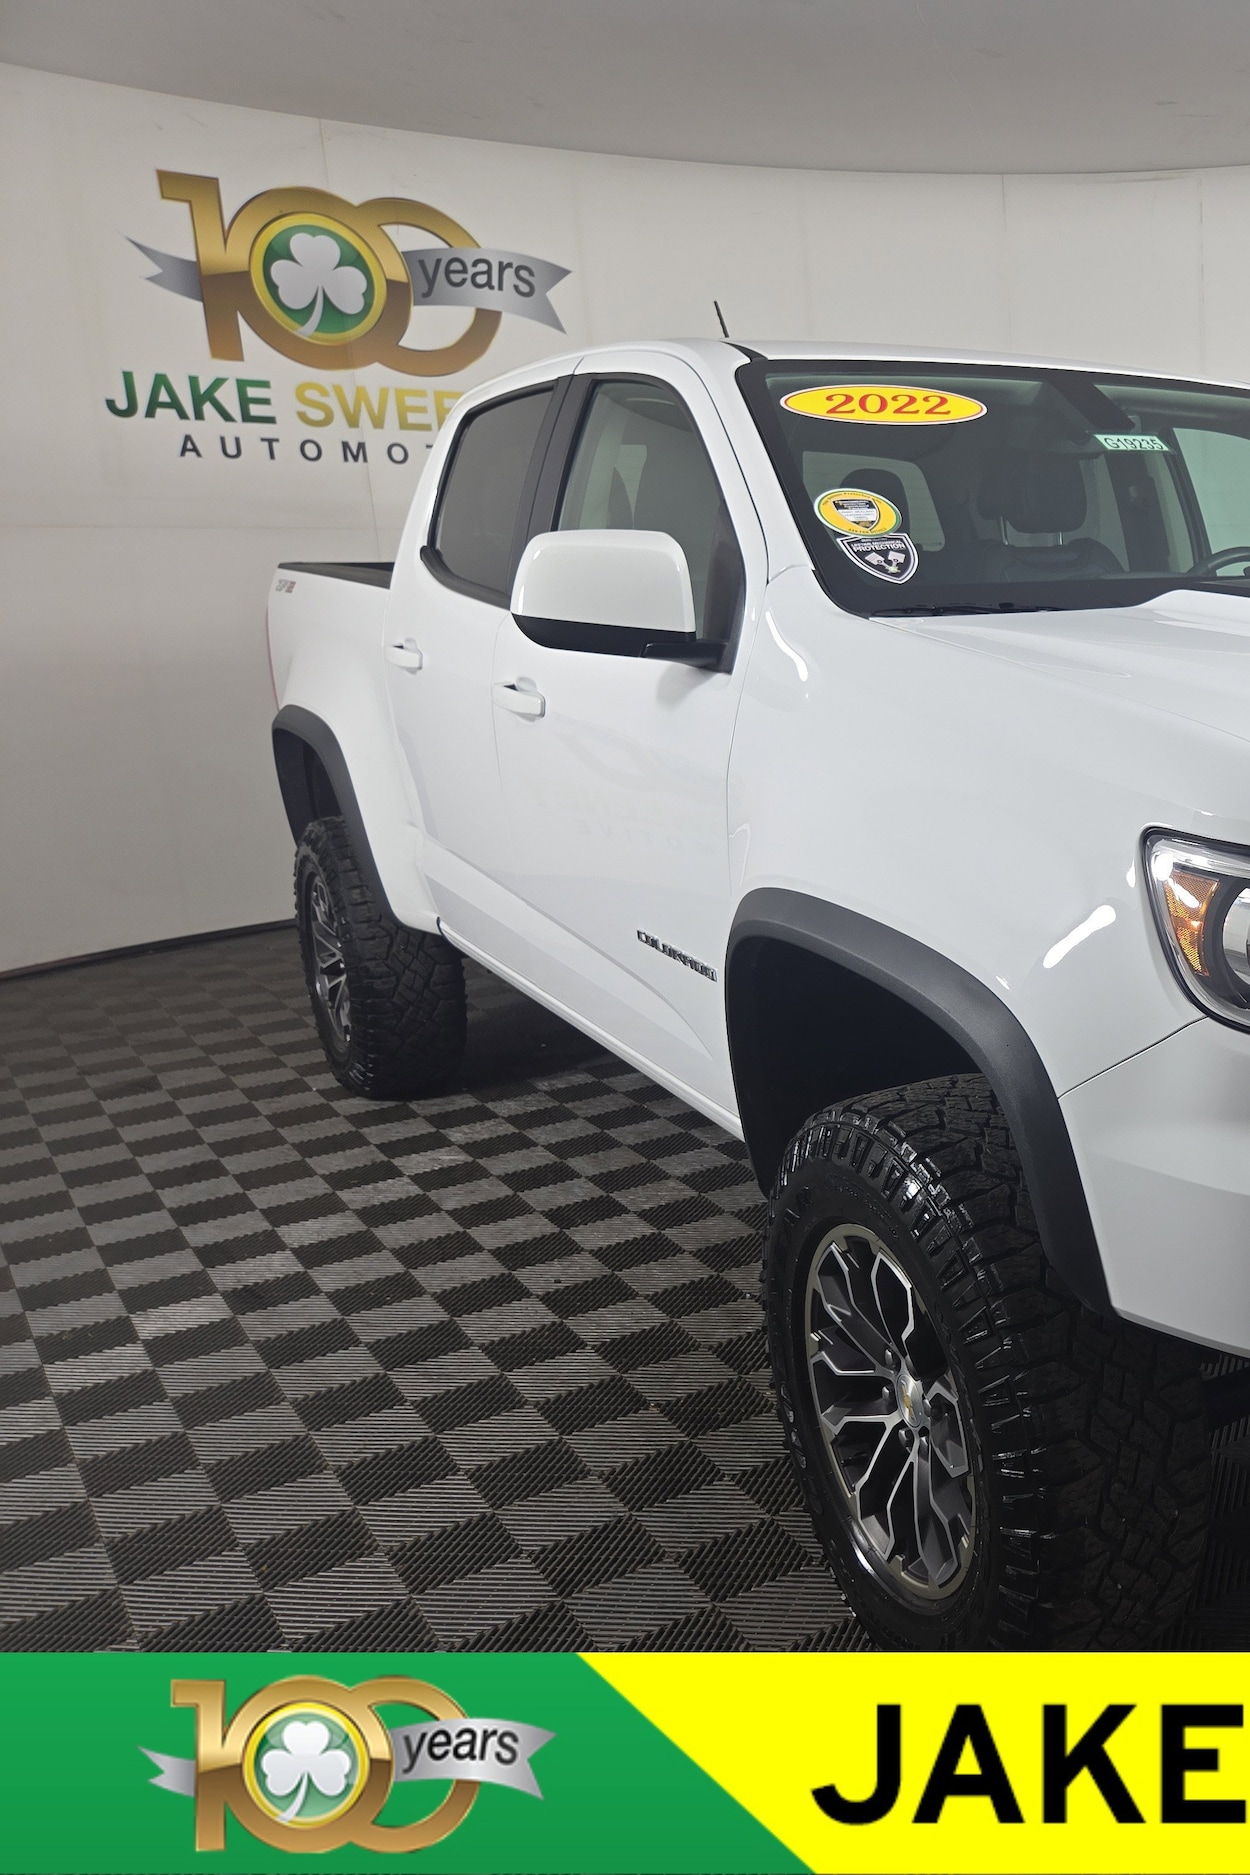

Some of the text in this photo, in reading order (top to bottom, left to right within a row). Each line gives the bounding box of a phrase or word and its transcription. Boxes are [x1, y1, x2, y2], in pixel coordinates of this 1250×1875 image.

[156, 169, 536, 377] 100 years
[105, 370, 464, 432] JAKE SWEE
[825, 393, 951, 415] 2022
[180, 434, 433, 466] AUTOMO
[1104, 437, 1164, 450] G19235
[852, 543, 906, 552] PROTECTION
